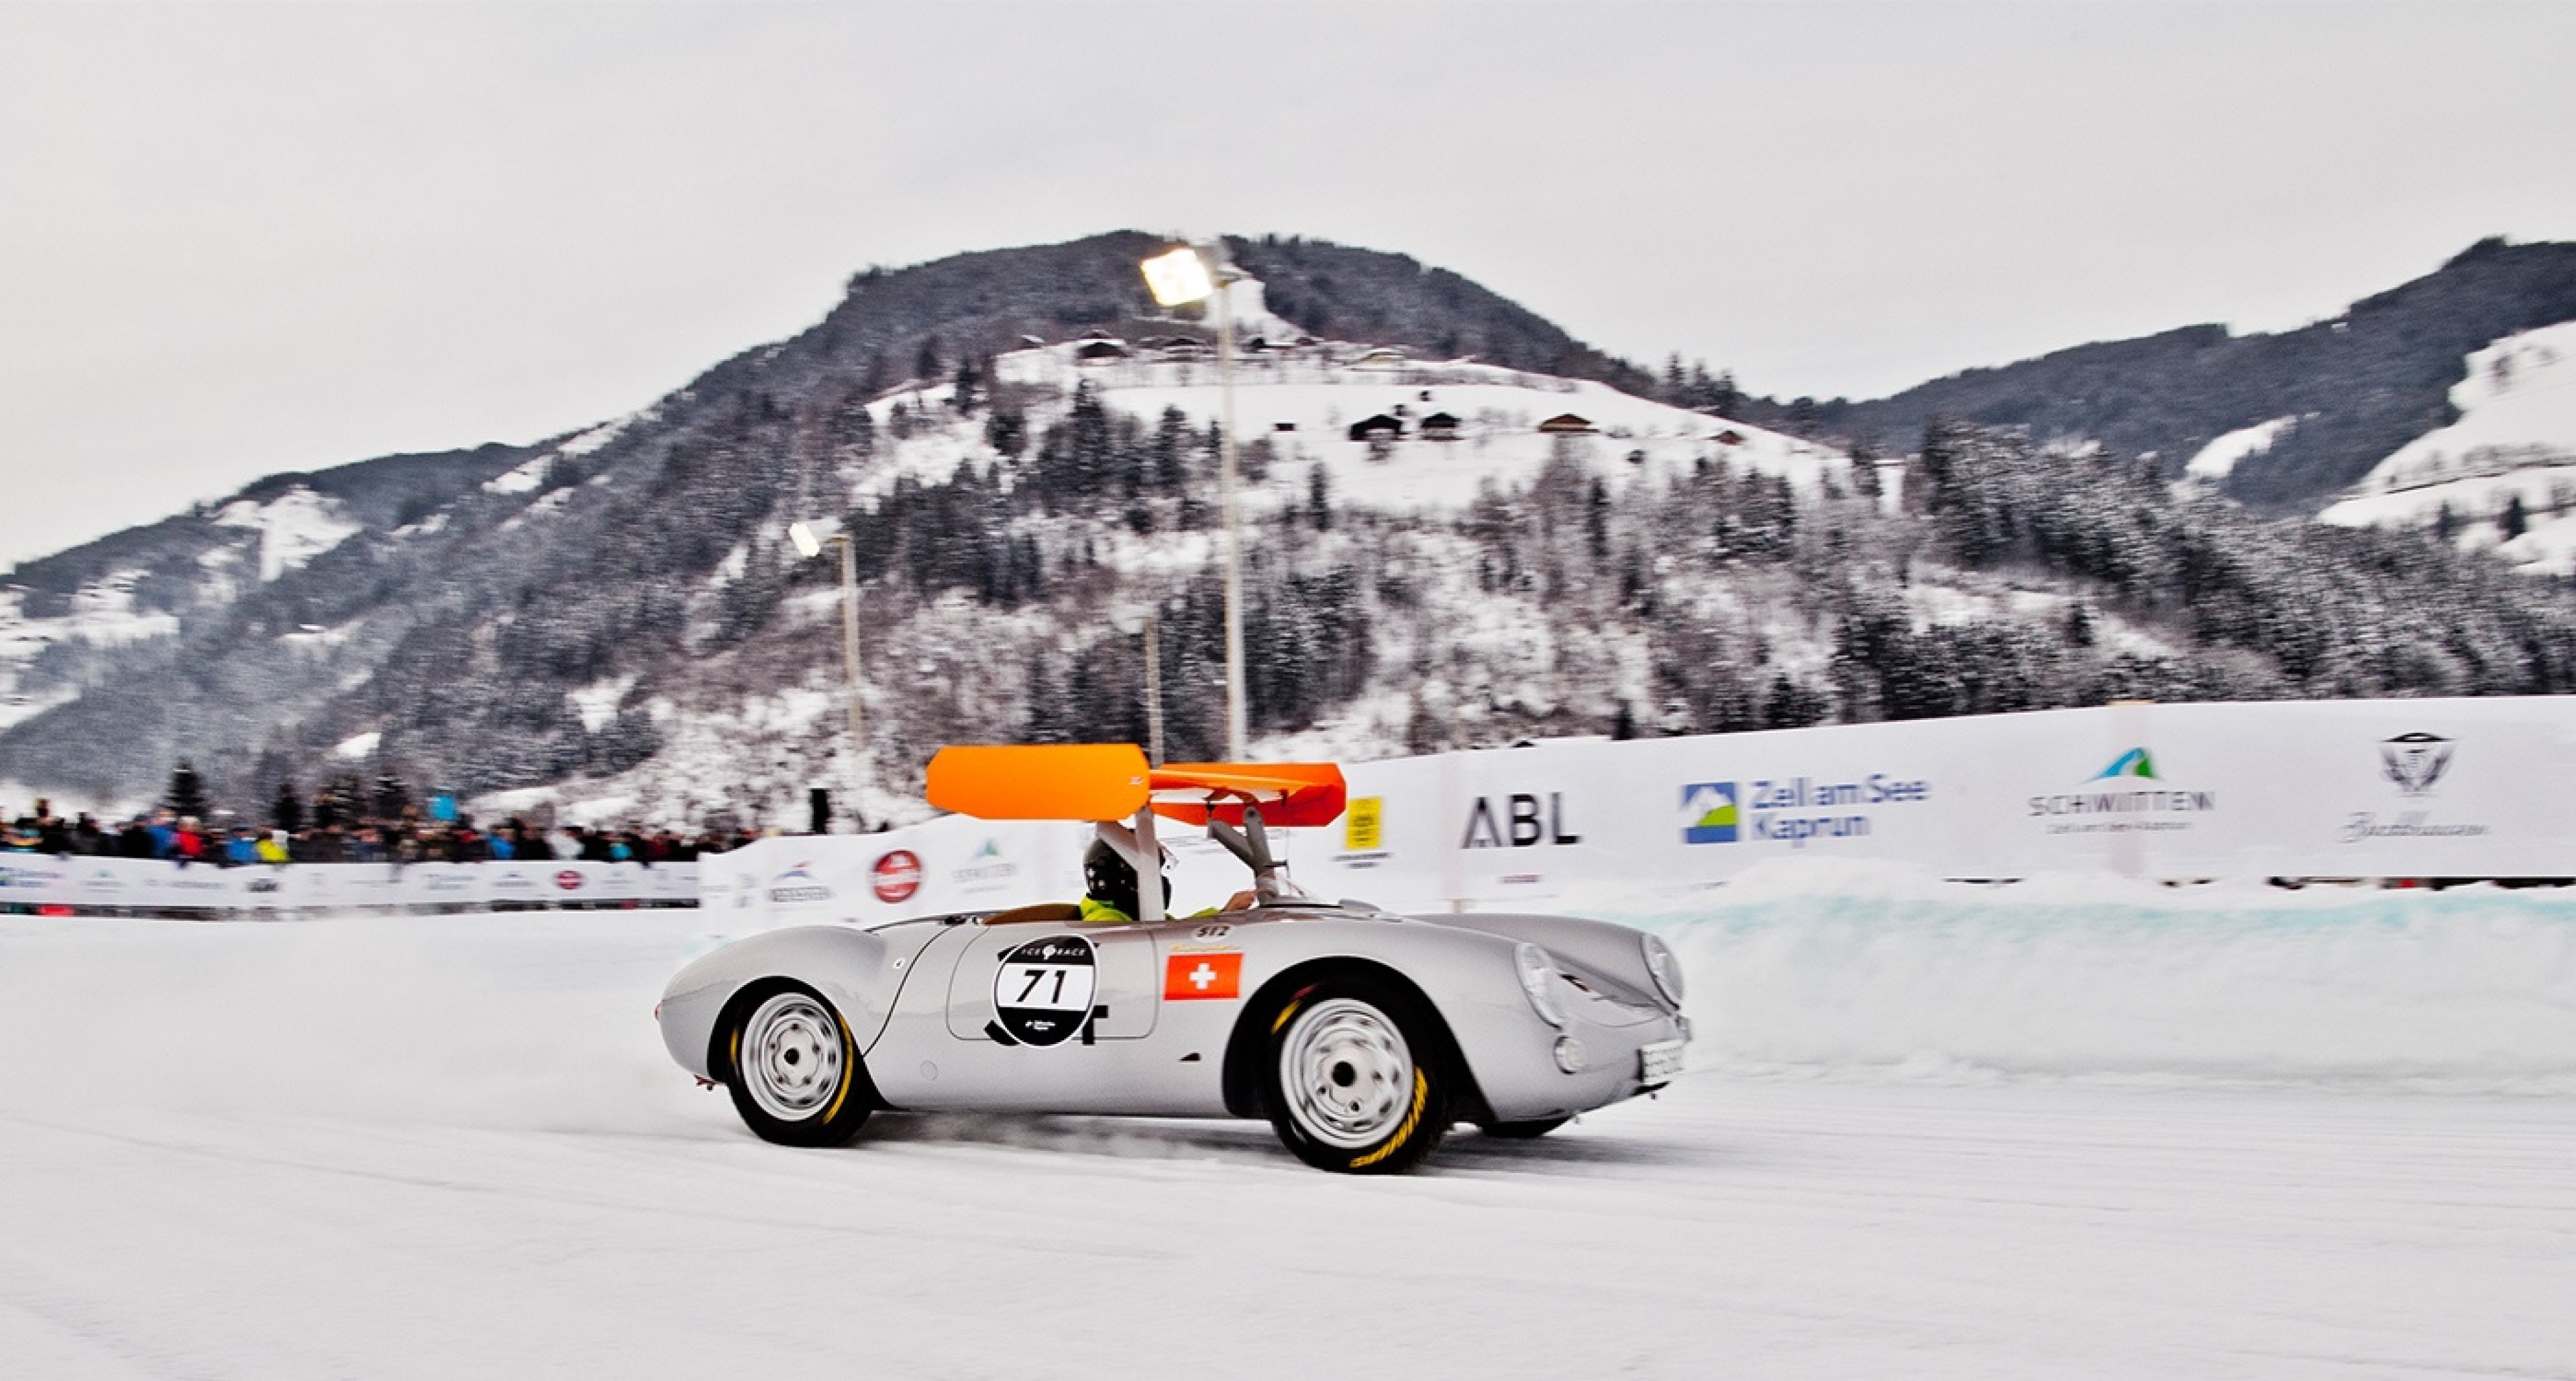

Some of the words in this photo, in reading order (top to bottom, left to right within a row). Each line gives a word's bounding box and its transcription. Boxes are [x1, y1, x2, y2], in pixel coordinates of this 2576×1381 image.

[1458, 791, 1584, 850] ABL
[1749, 812, 1872, 848] Kaprun
[1015, 969, 1067, 1004] 71
